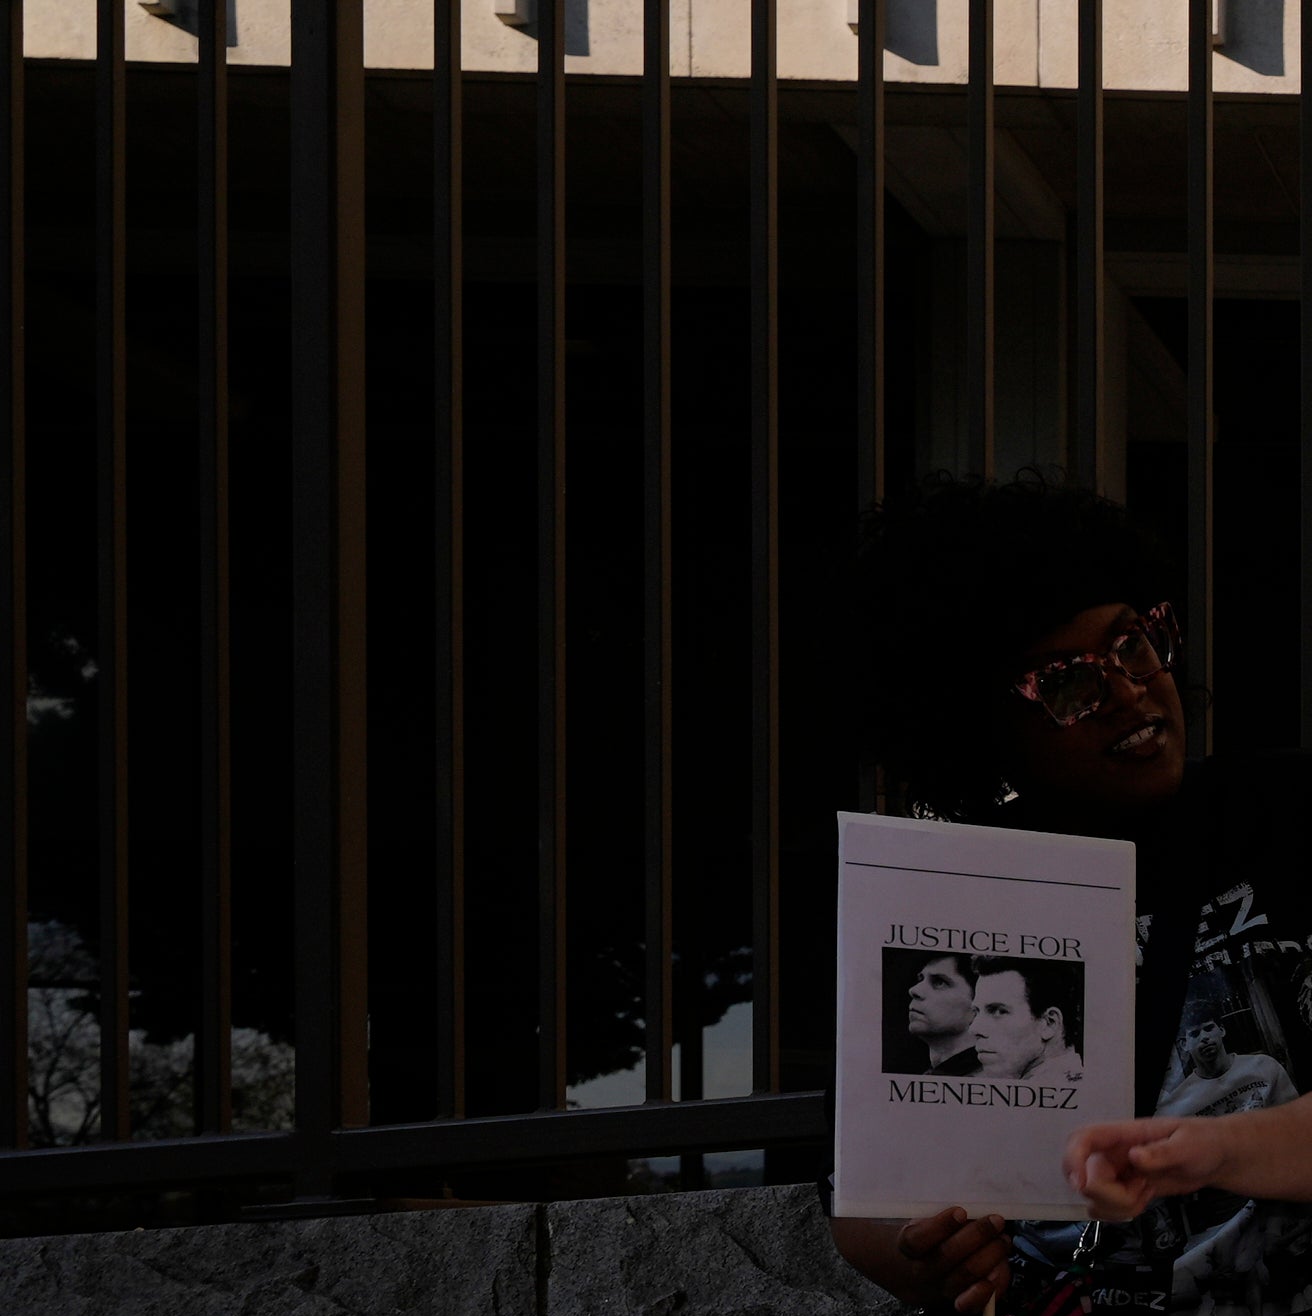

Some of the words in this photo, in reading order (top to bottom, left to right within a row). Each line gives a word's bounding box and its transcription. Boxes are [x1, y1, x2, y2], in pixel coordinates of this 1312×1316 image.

[884, 924, 1010, 954] JUSTICE
[1019, 936, 1081, 957] FOR
[889, 1079, 1078, 1109] MENENDEZ
